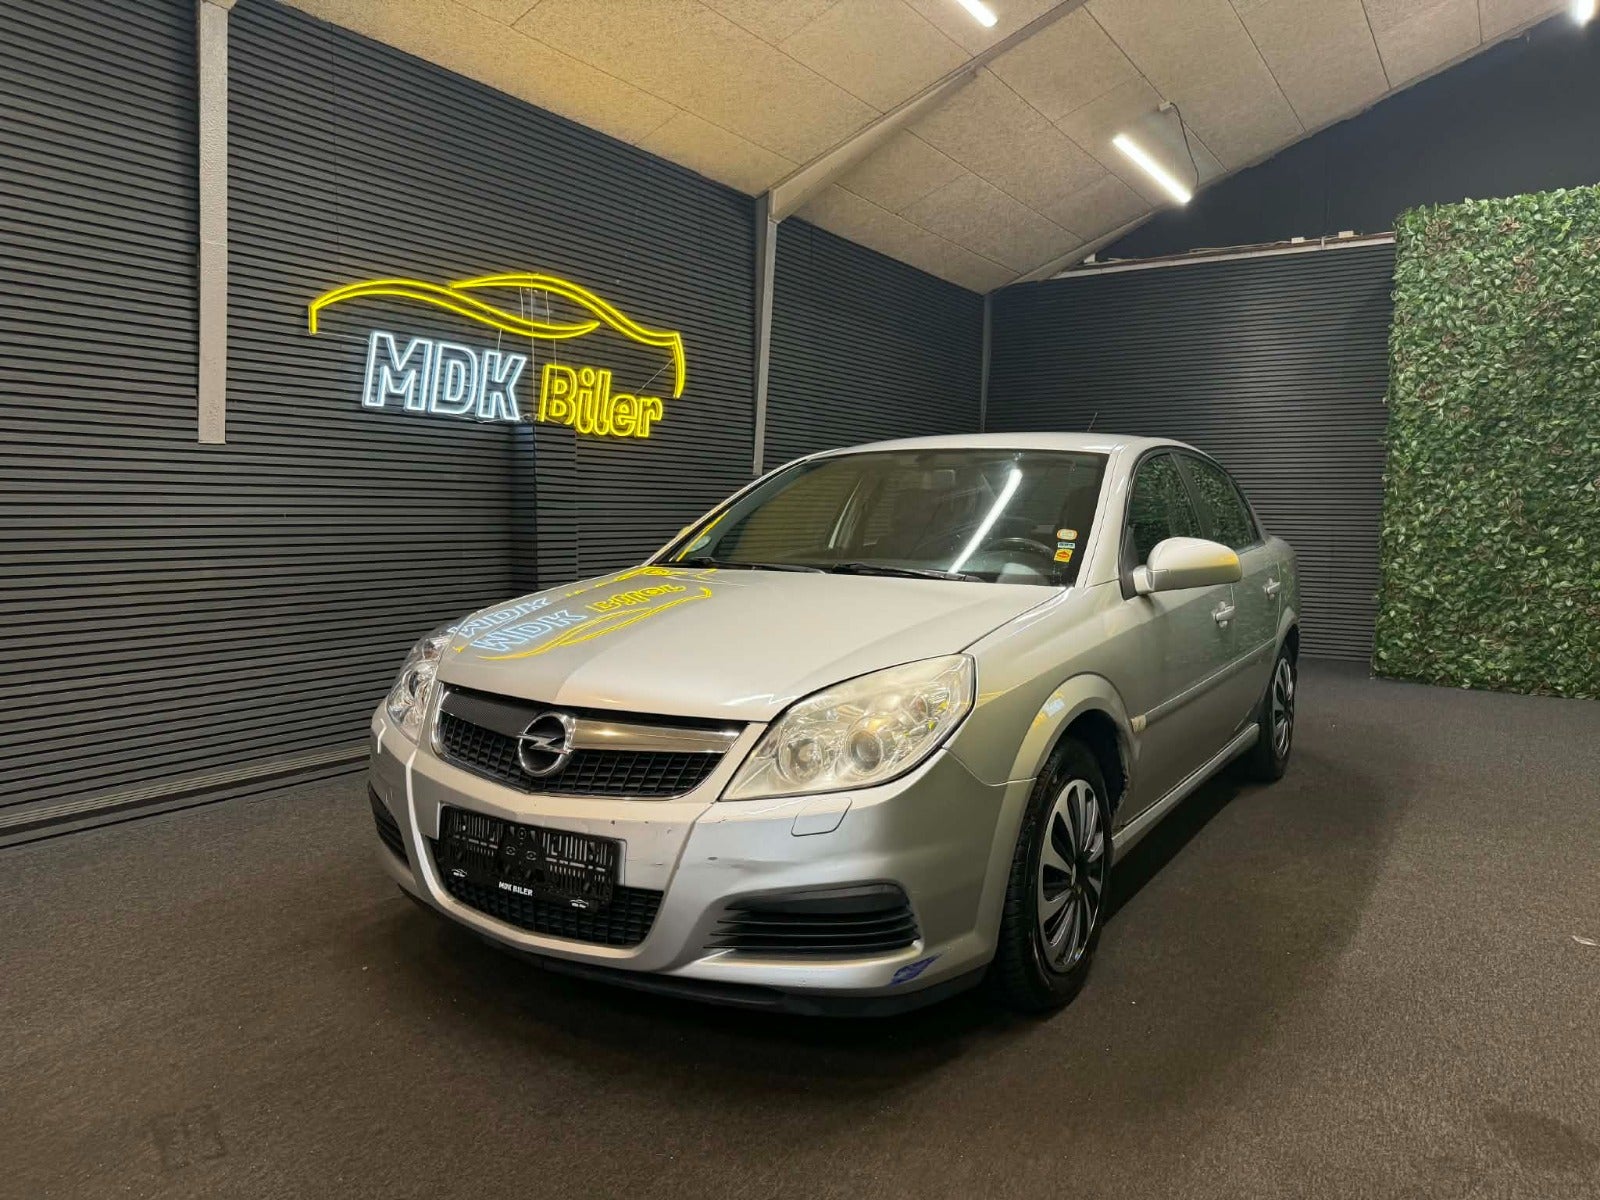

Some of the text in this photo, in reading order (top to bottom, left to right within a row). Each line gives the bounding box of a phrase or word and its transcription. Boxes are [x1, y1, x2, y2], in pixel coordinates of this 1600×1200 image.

[362, 330, 663, 438] MDK Biler
[498, 881, 533, 897] MDK BILER
